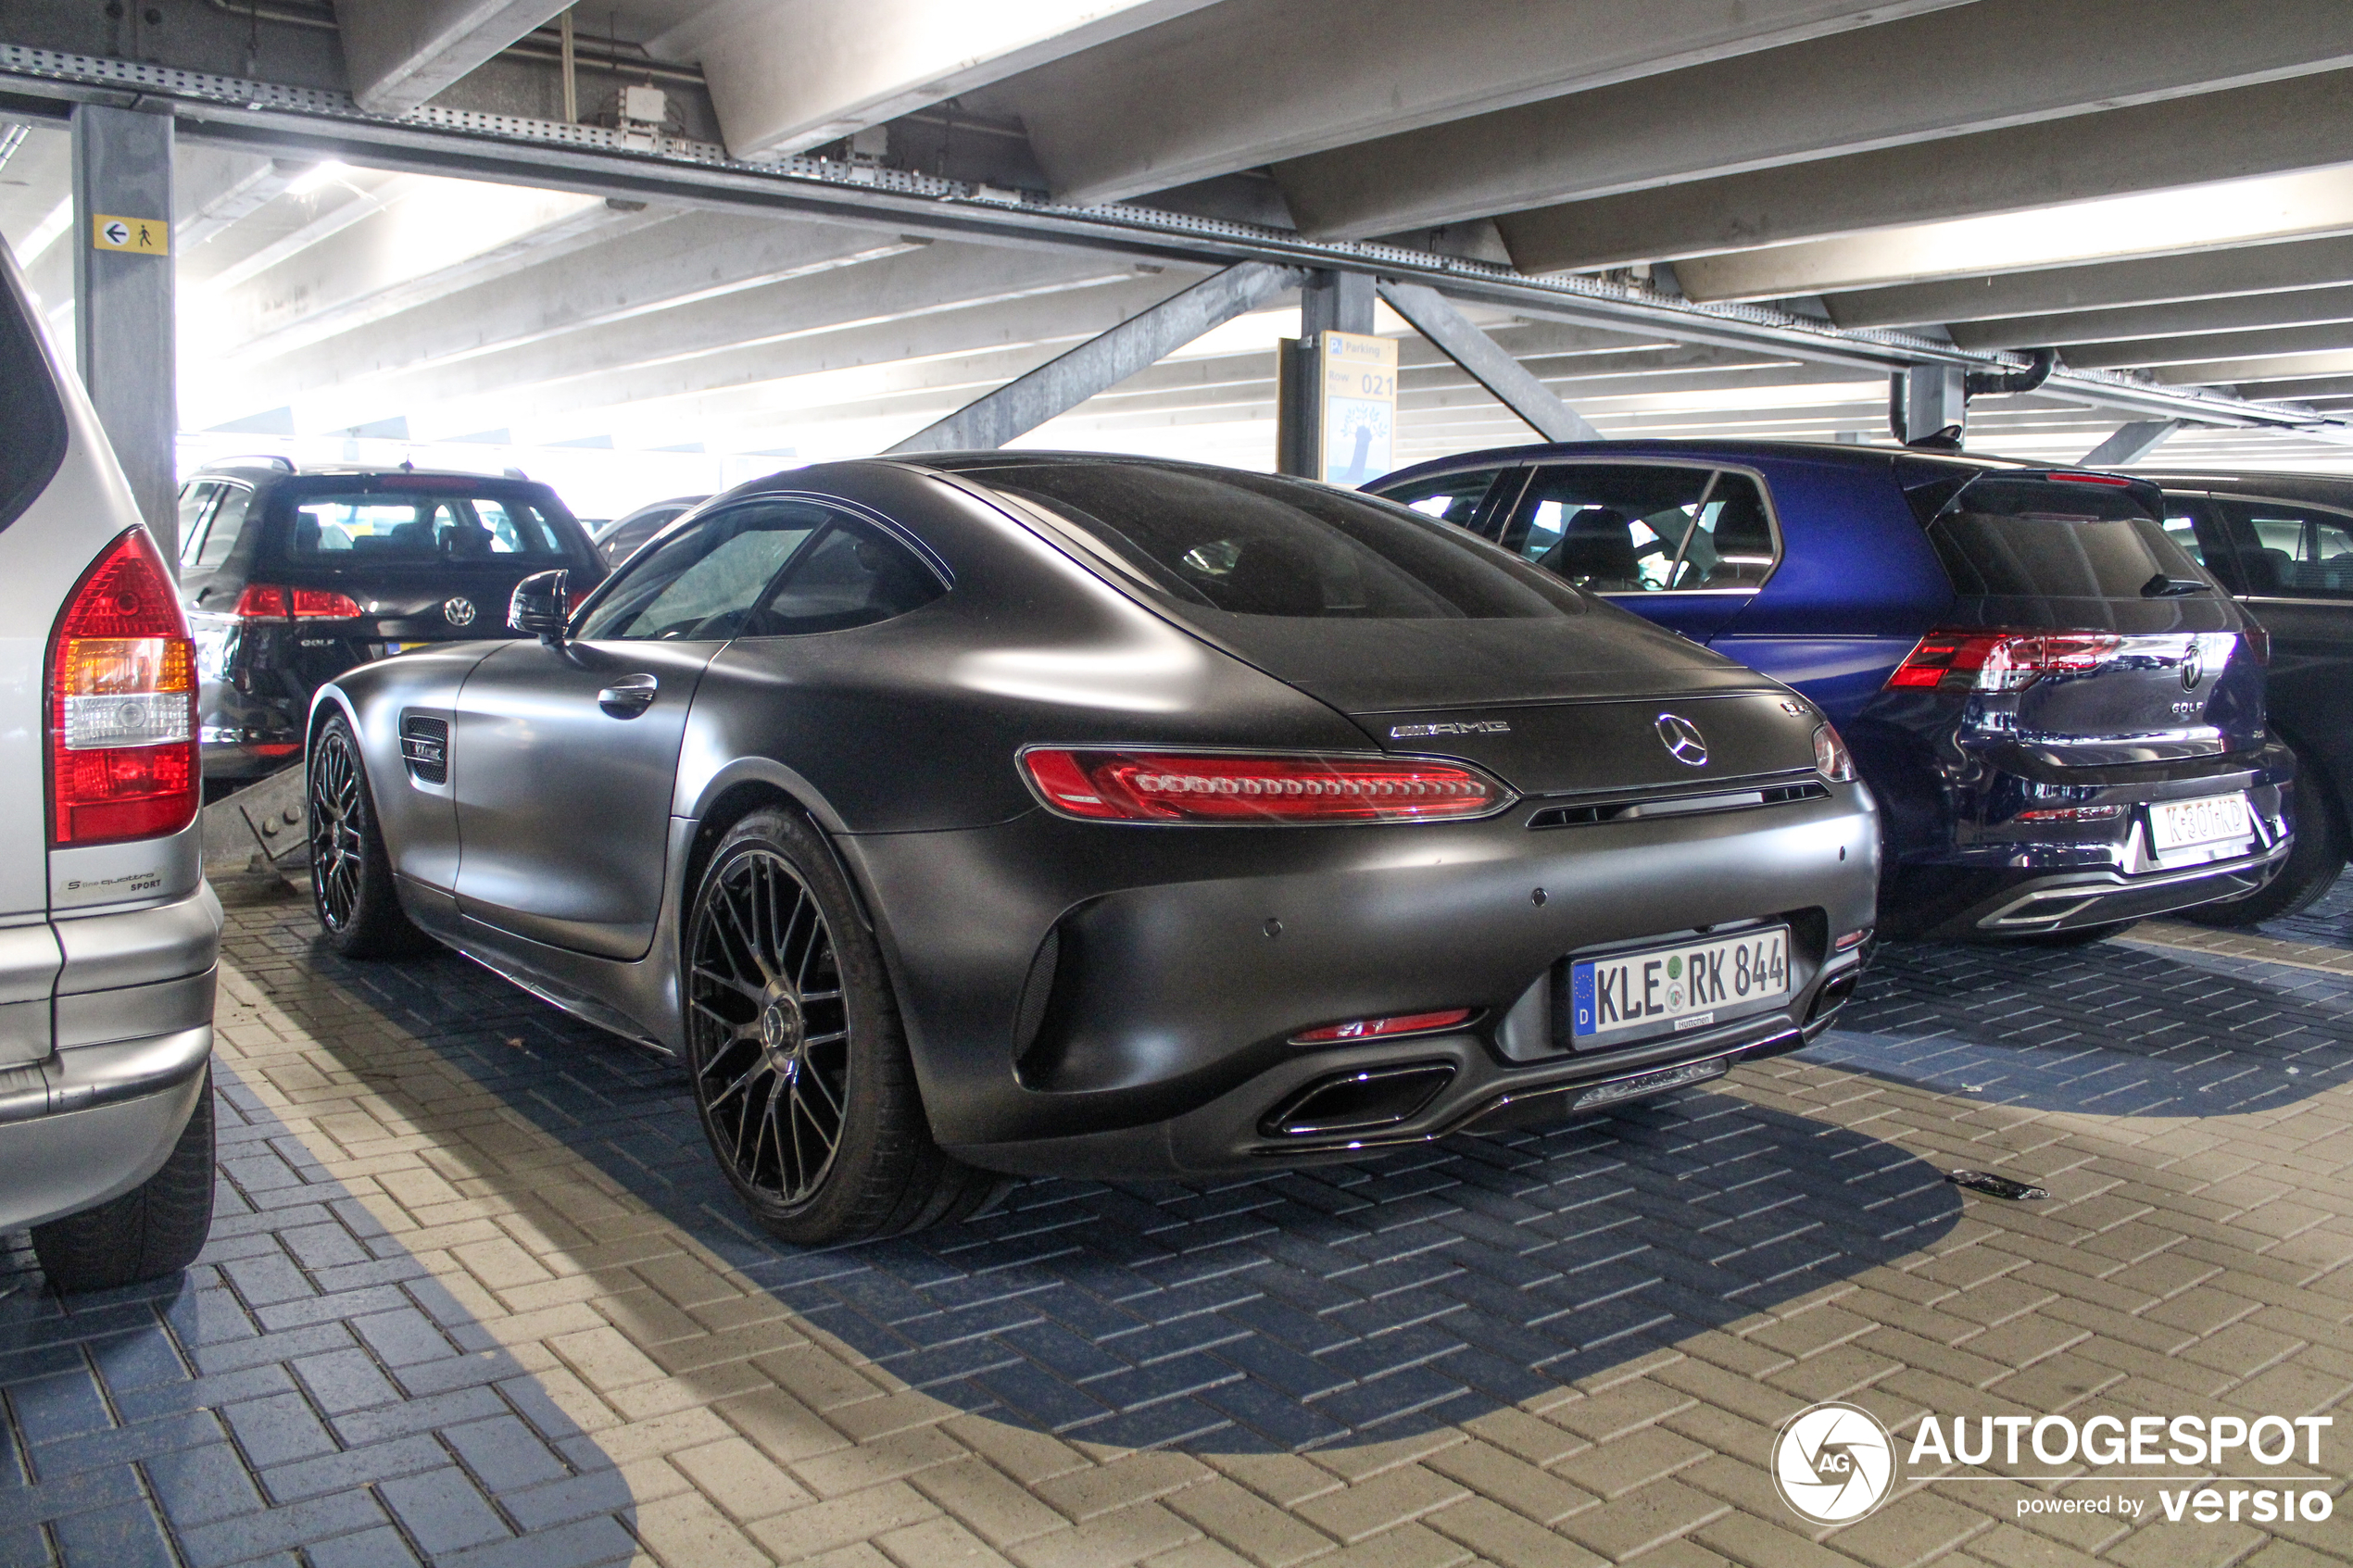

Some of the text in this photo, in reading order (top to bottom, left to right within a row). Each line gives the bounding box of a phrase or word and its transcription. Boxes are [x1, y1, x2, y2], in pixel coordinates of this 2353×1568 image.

[1346, 342, 1380, 358] Parking
[1328, 370, 1350, 382] Row
[1362, 373, 1393, 396] 021
[2171, 701, 2204, 714] GOLF
[1431, 721, 1511, 735] AMG
[101, 872, 155, 886] quattro
[131, 878, 162, 892] SPORT
[1597, 935, 1784, 1025] KLE RK 844
[1579, 1009, 1589, 1025] D
